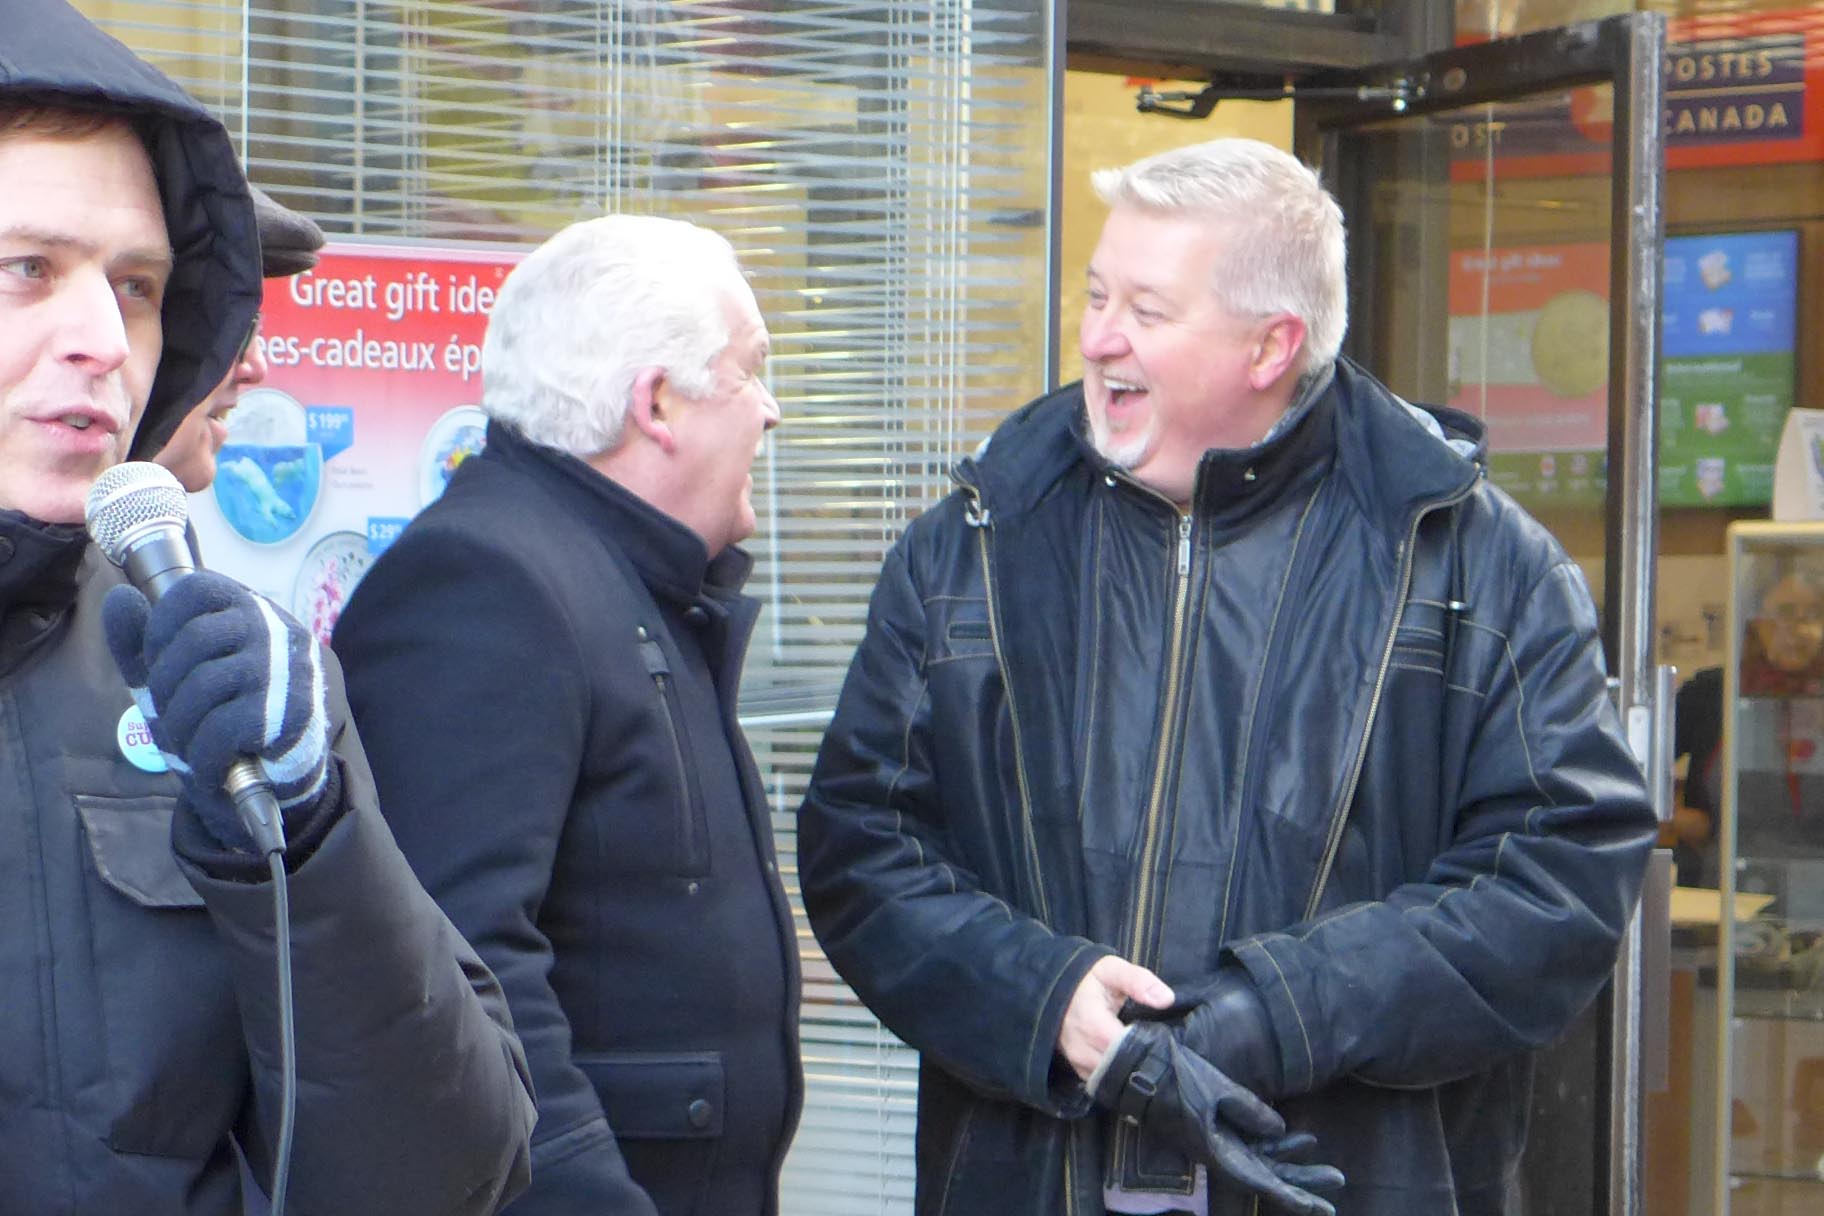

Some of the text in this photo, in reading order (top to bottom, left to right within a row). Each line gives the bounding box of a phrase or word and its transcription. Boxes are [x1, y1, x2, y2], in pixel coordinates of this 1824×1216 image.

[290, 271, 498, 321] Great gift ide
[444, 334, 484, 381] ép
